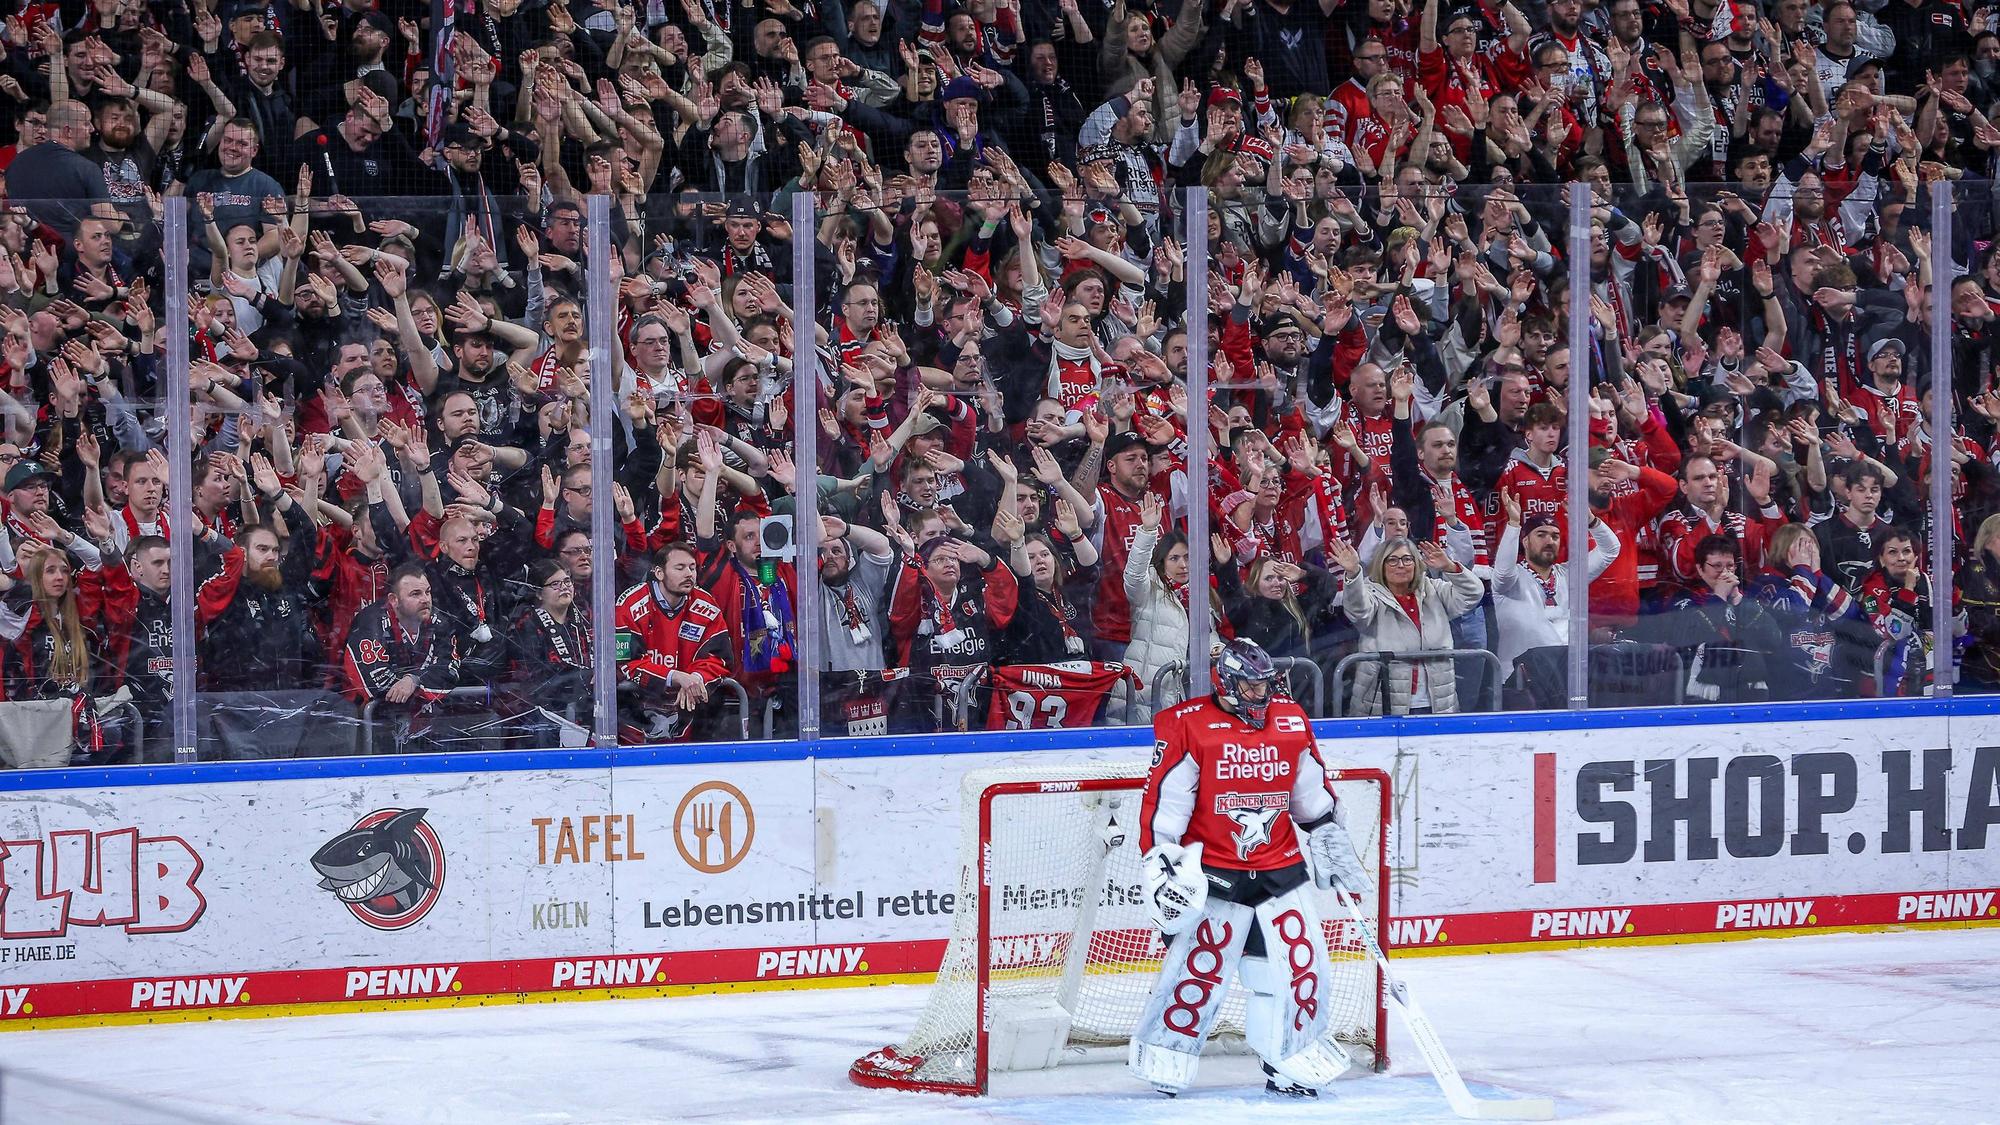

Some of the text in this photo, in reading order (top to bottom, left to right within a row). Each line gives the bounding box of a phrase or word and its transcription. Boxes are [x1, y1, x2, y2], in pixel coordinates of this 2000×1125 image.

[1060, 382, 1093, 394] Rhei
[691, 603, 716, 617] HIT
[360, 639, 390, 665] 82
[1006, 691, 1067, 730] 93
[1223, 743, 1279, 763] Rhein
[1216, 759, 1291, 782] Energie
[1217, 793, 1288, 810] KÖLNER HAIE
[531, 814, 645, 866] TAFEL
[0, 826, 207, 940] LUB
[531, 897, 590, 931] KÖLN
[643, 890, 864, 929] Lebensmittel
[15, 945, 76, 963] HAIE.DE
[1163, 918, 1233, 1038] pape
[1271, 909, 1319, 1032] pape
